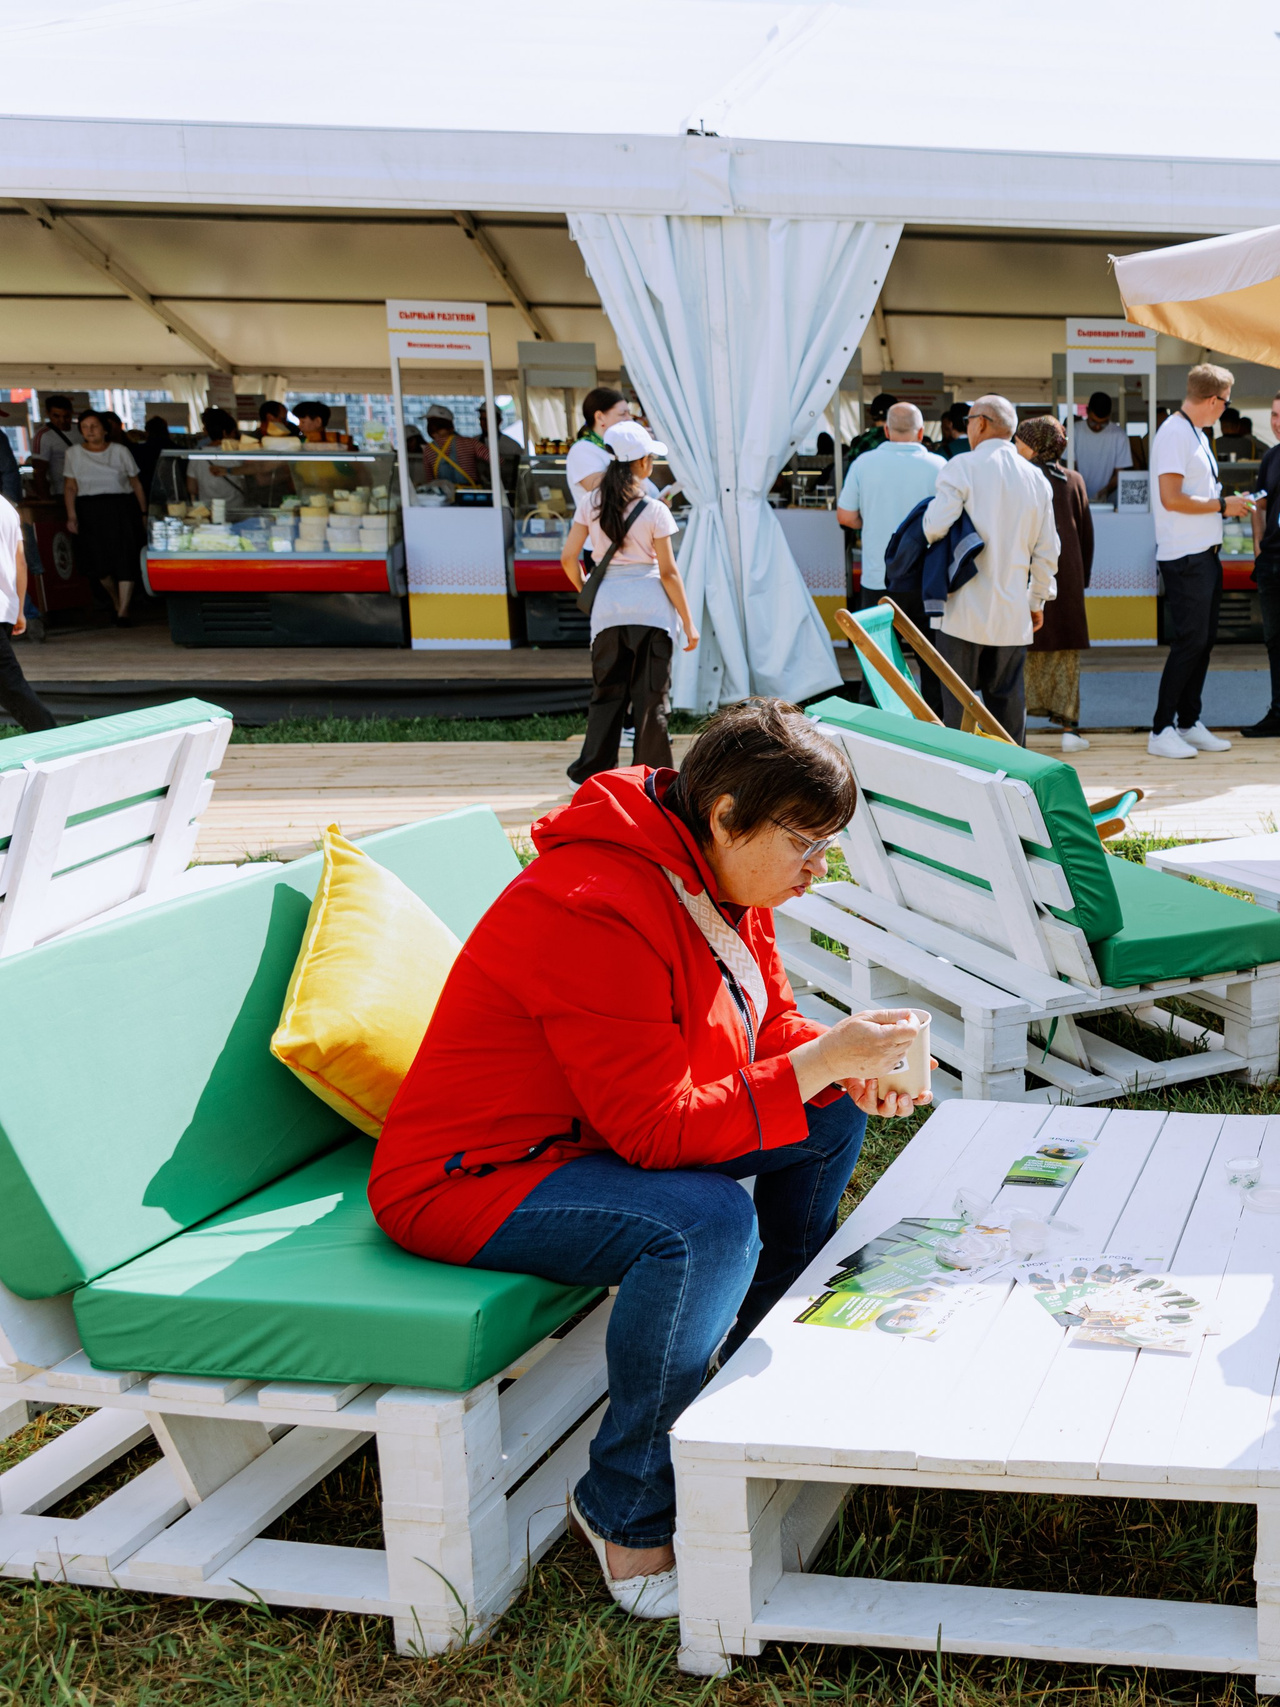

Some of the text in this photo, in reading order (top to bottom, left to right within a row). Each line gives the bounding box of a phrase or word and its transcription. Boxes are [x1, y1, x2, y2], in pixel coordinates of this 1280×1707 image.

[398, 311, 476, 322] СЫРНЫЙ РАЗГУЛЯЙ
[1121, 330, 1146, 339] Fratelli
